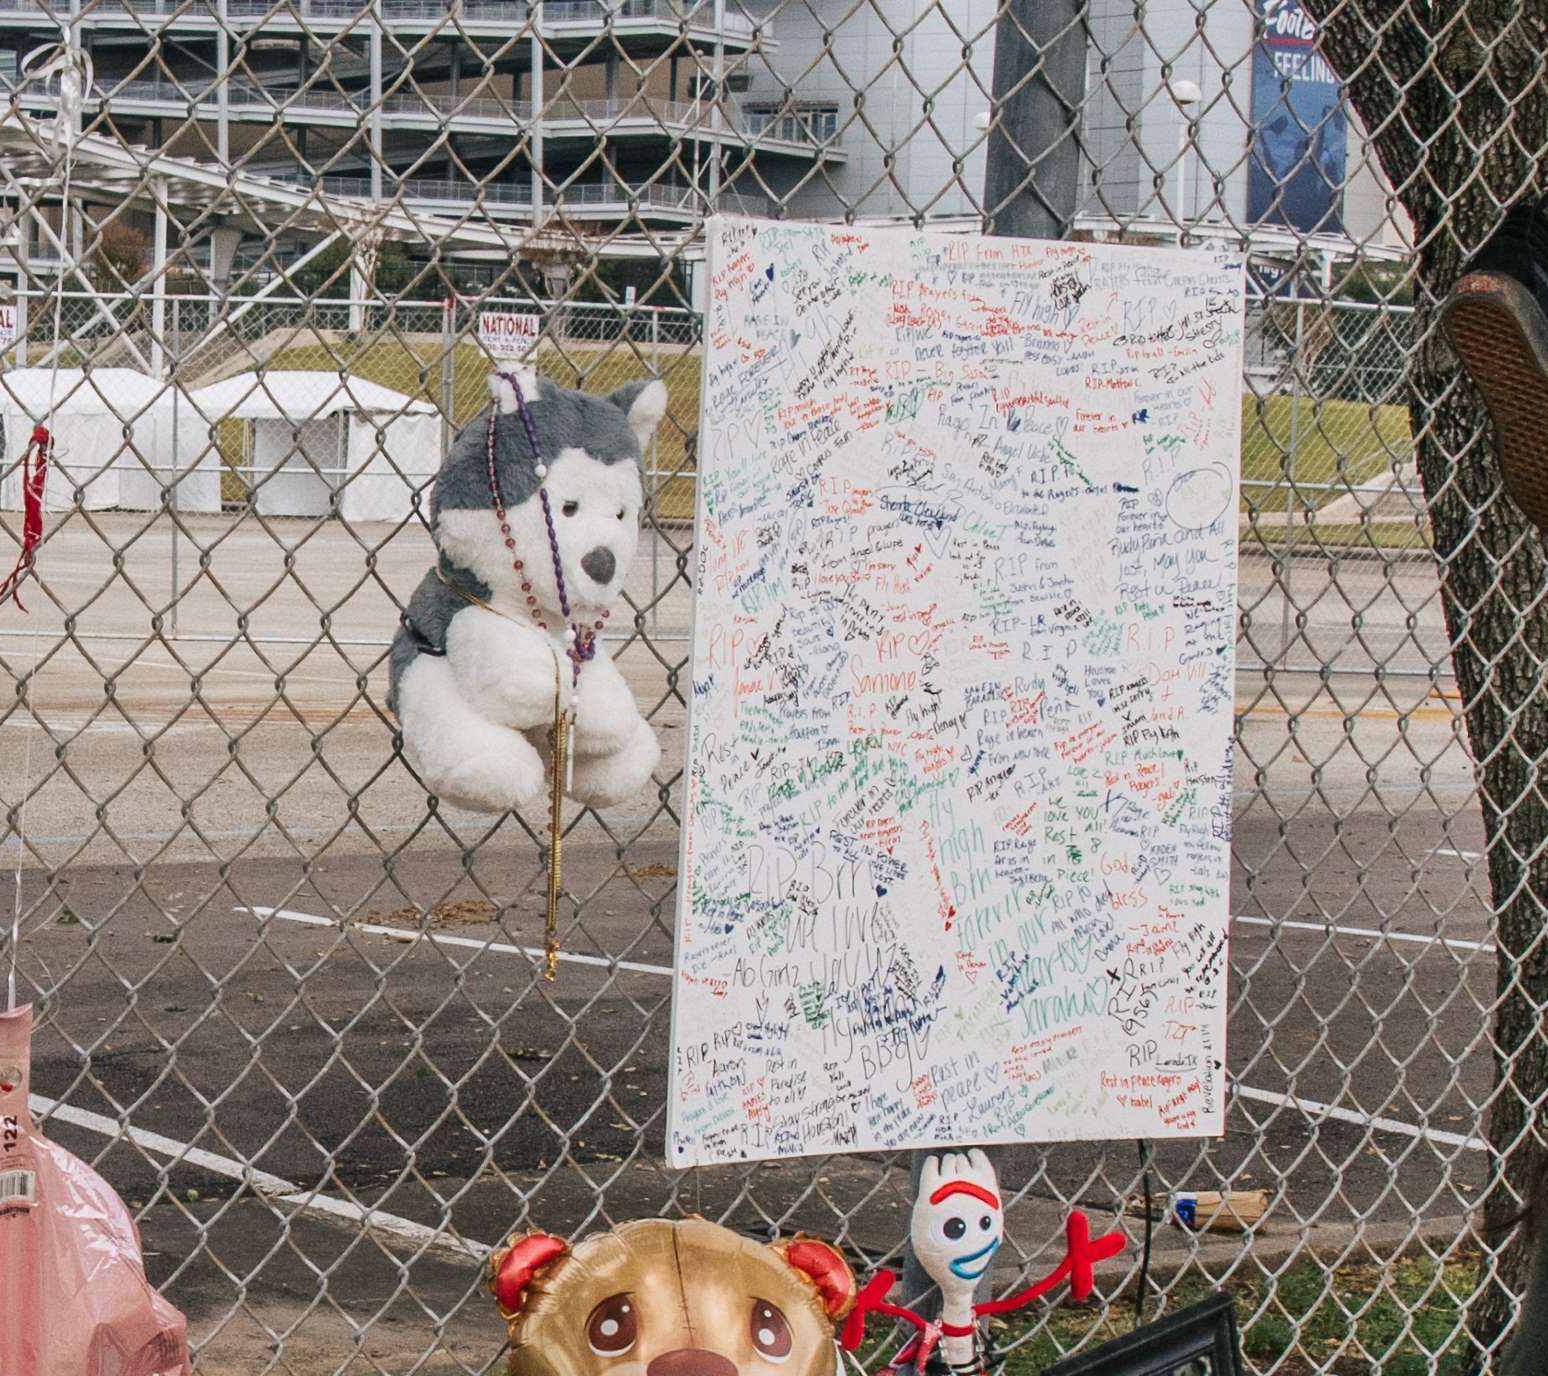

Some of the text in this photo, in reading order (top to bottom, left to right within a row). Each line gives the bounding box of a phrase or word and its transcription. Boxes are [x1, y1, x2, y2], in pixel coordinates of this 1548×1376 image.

[482, 314, 536, 337] NATIONAL
[1126, 1039, 1158, 1069] RIP
[3, 1114, 19, 1154] 122
